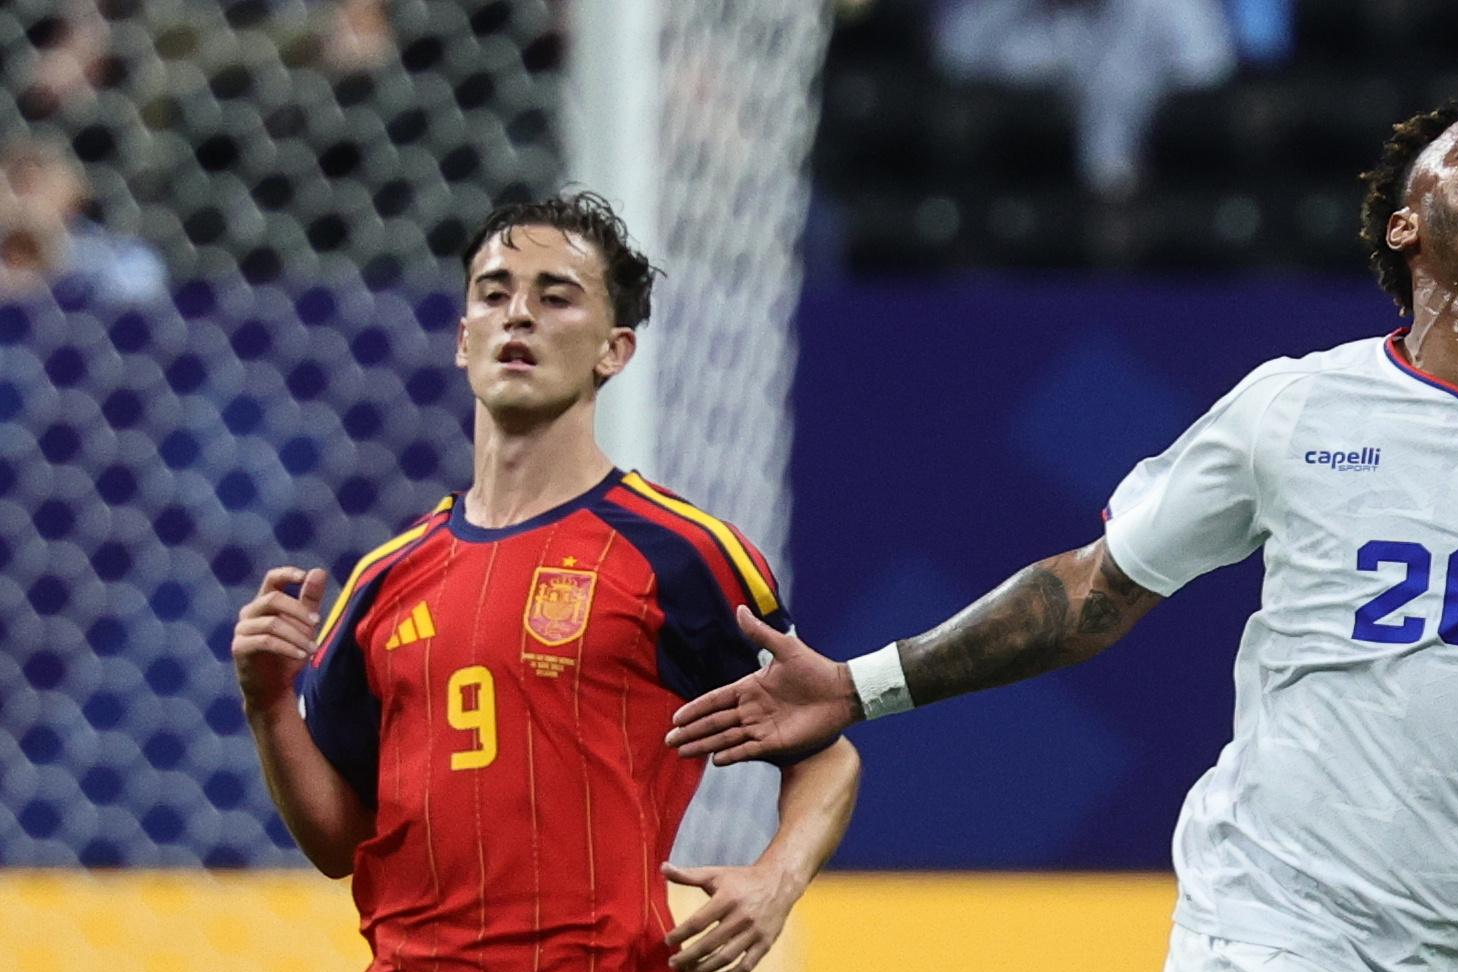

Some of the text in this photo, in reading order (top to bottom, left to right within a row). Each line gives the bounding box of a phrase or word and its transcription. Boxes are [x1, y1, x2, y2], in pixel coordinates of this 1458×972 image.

[1304, 447, 1381, 469] capelli
[1337, 464, 1379, 473] SPORT
[448, 666, 497, 770] 9
